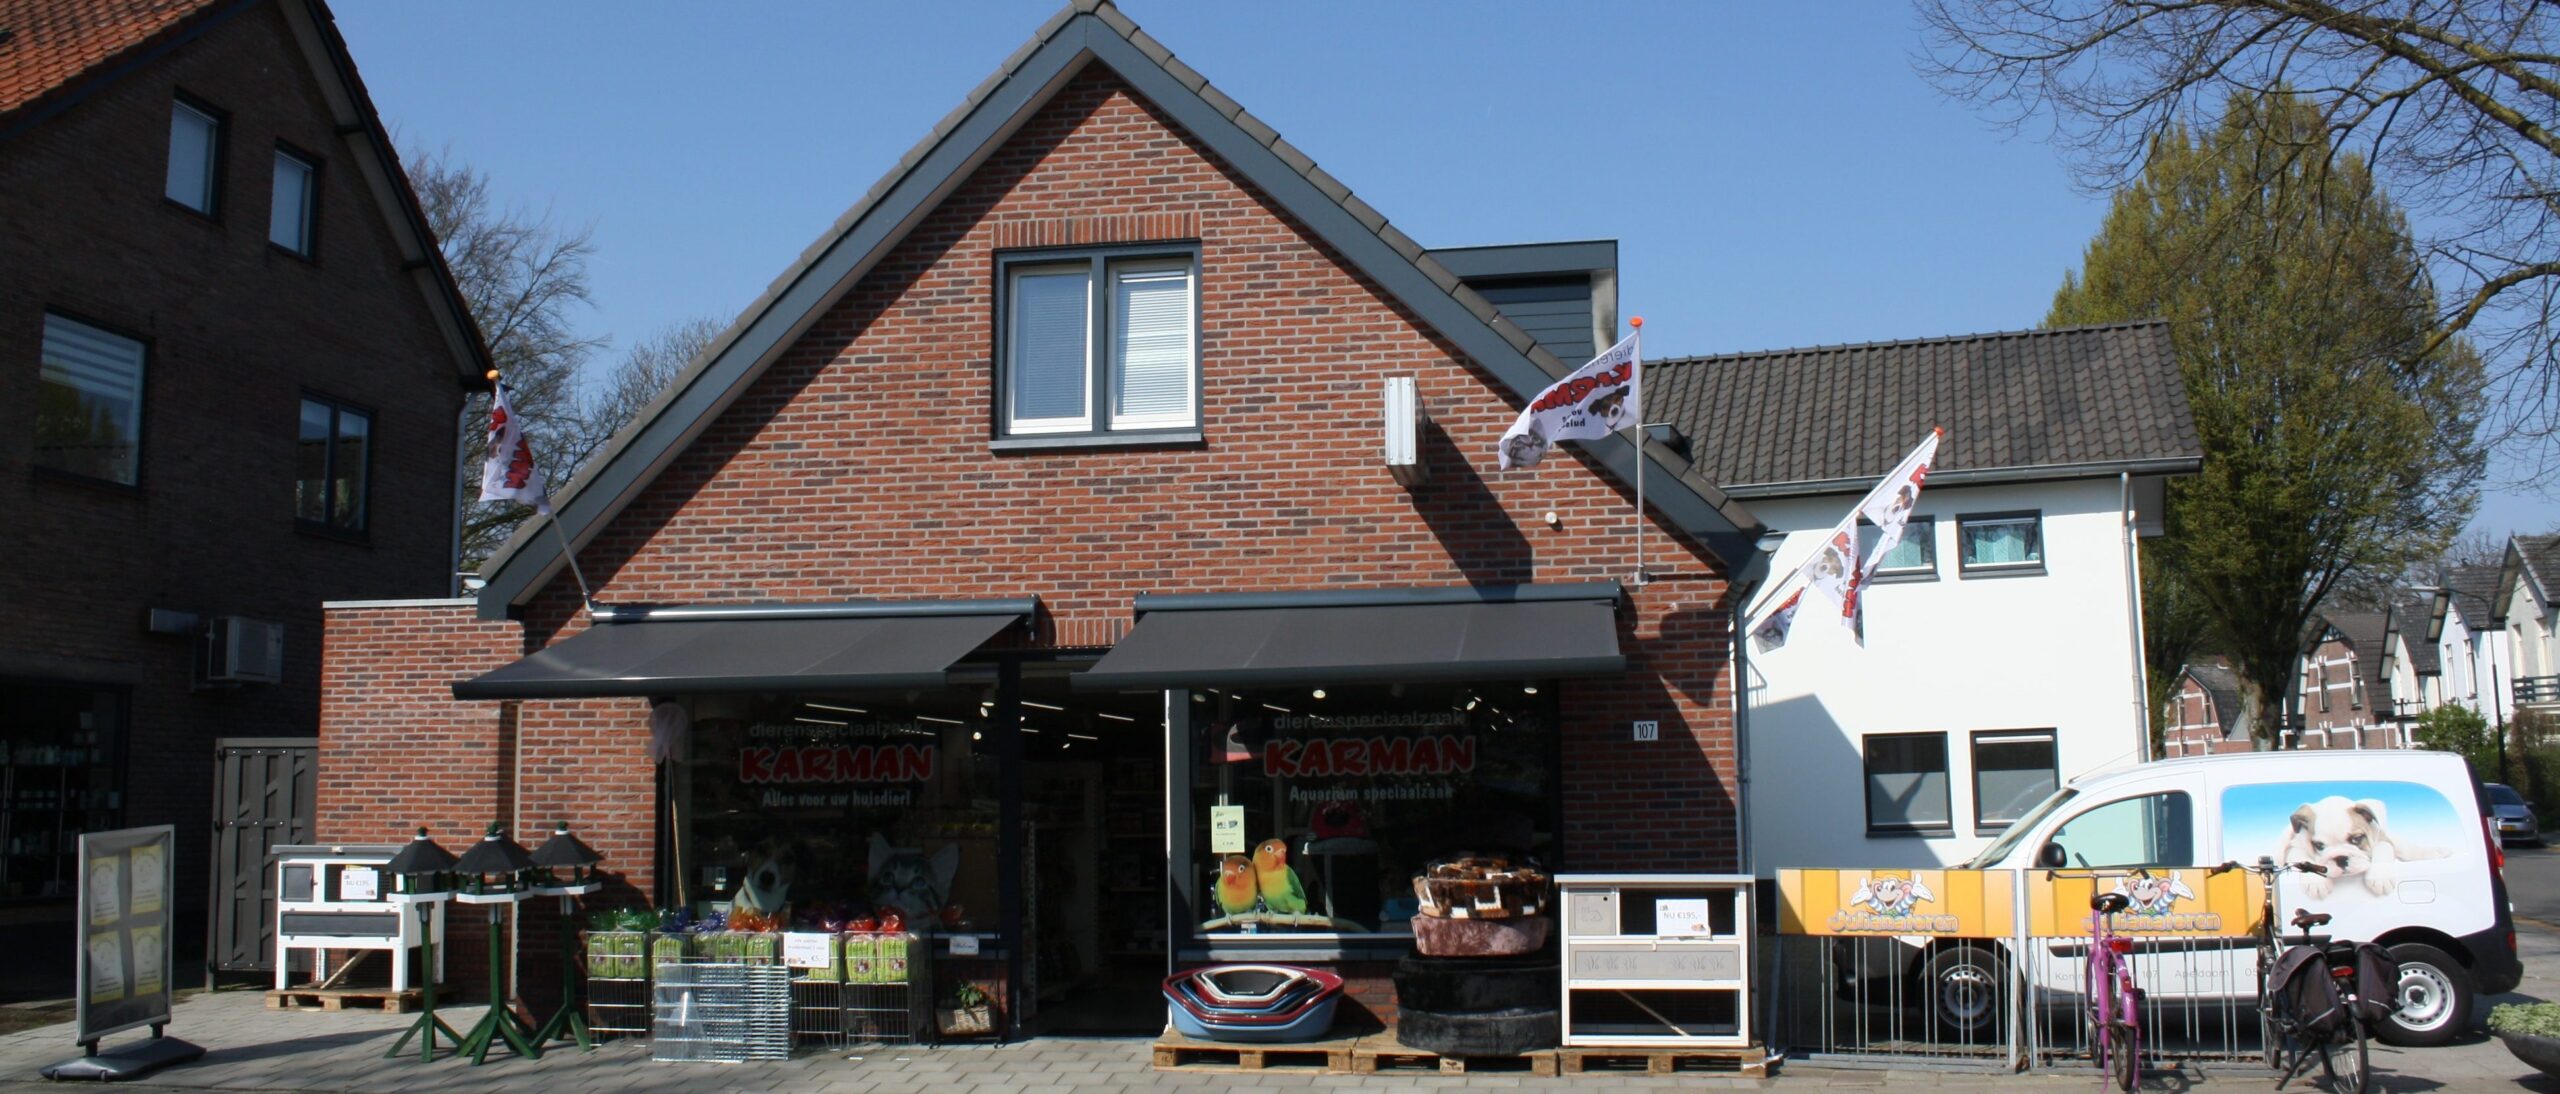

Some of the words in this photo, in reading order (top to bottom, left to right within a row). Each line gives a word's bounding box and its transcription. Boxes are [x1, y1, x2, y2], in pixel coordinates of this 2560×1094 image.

[750, 720, 922, 738] dierenspeciaalzaak
[1274, 711, 1465, 730] dierenspeciaalzaak
[1637, 723, 1654, 739] 107
[739, 743, 935, 784] KARMAN
[1264, 735, 1476, 778] KARMAN
[762, 790, 795, 807] Alles
[798, 792, 826, 807] voor
[831, 793, 849, 807] uw
[852, 789, 911, 807] huisdier!
[1289, 785, 1359, 802] Aquarium
[1363, 784, 1454, 802] speciaalzaak
[1826, 910, 1958, 932] Julianatoren
